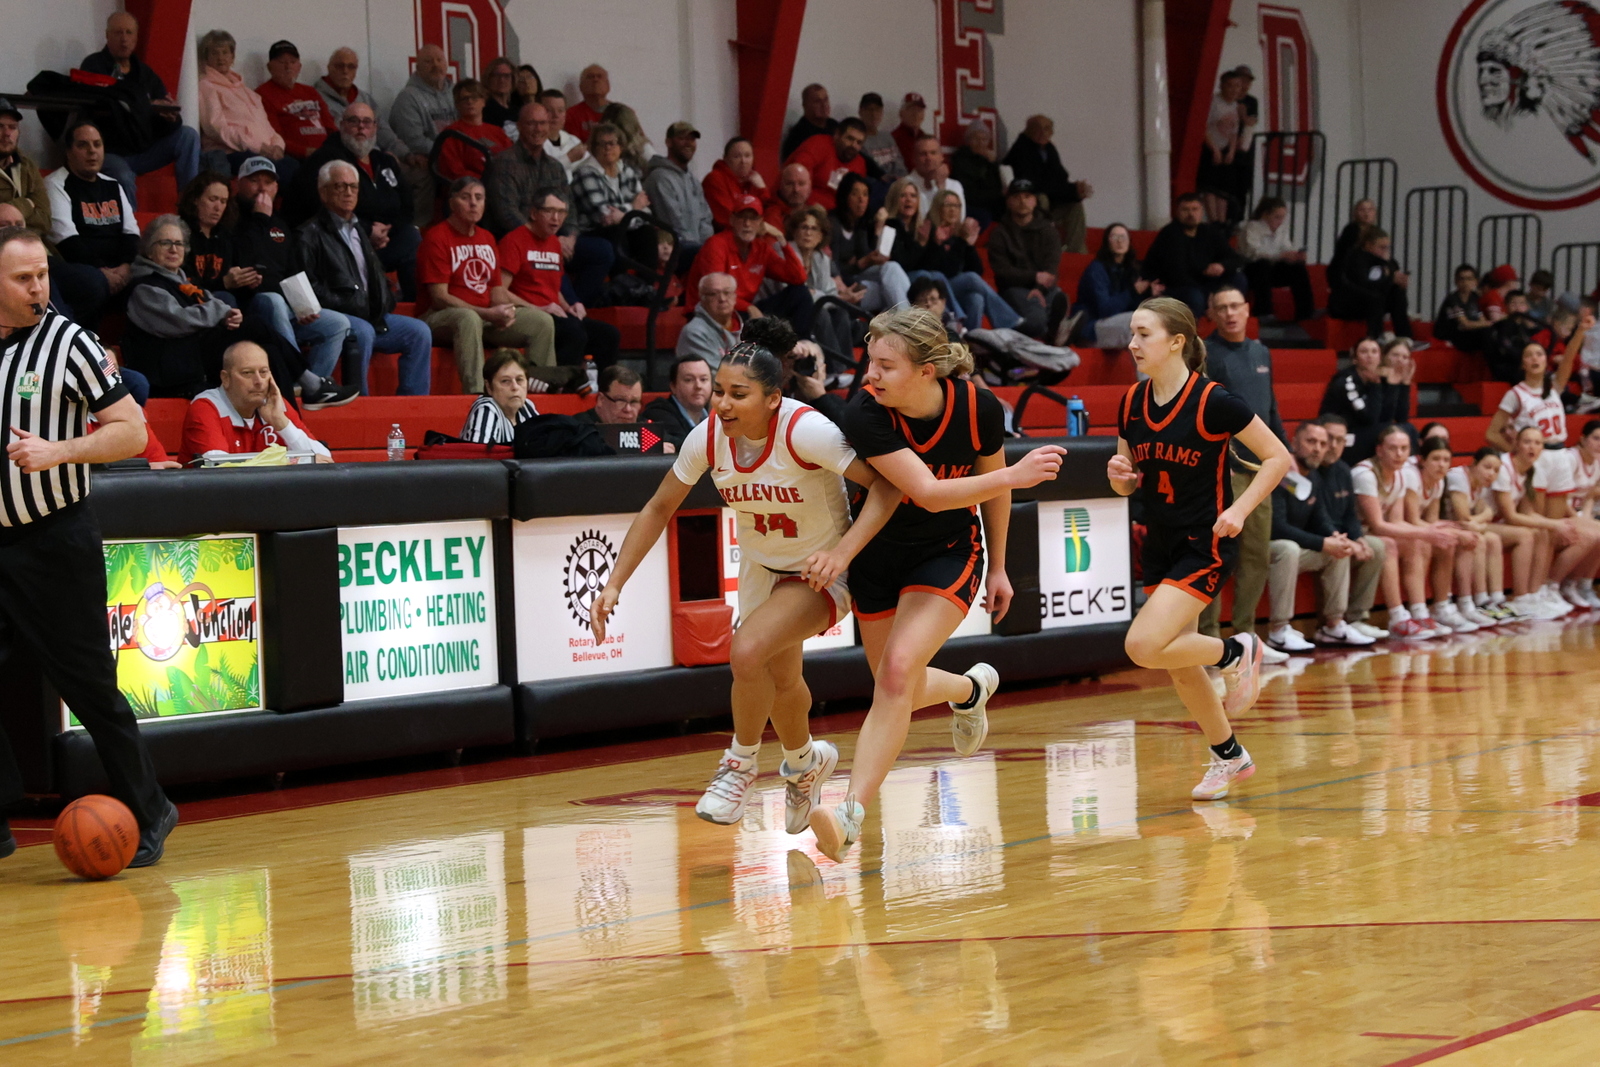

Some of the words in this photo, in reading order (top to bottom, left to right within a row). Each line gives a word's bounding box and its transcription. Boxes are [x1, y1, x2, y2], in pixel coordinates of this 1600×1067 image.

[450, 244, 474, 273] LADY
[475, 244, 496, 270] RED
[260, 425, 277, 446] B
[1538, 416, 1562, 437] 20
[1132, 442, 1151, 463] ADY
[1155, 442, 1201, 466] RAMS
[1157, 471, 1175, 504] 4
[579, 539, 604, 552] ROTARY
[338, 536, 486, 587] BECKLEY
[426, 591, 486, 627] HEATING
[1040, 586, 1127, 619] BECK'S
[569, 637, 595, 648] Rotary
[616, 632, 625, 643] of
[345, 650, 369, 684] AIR
[376, 639, 480, 681] CONDITIONING
[572, 652, 609, 662] Bellevue,
[610, 648, 623, 658] OH
